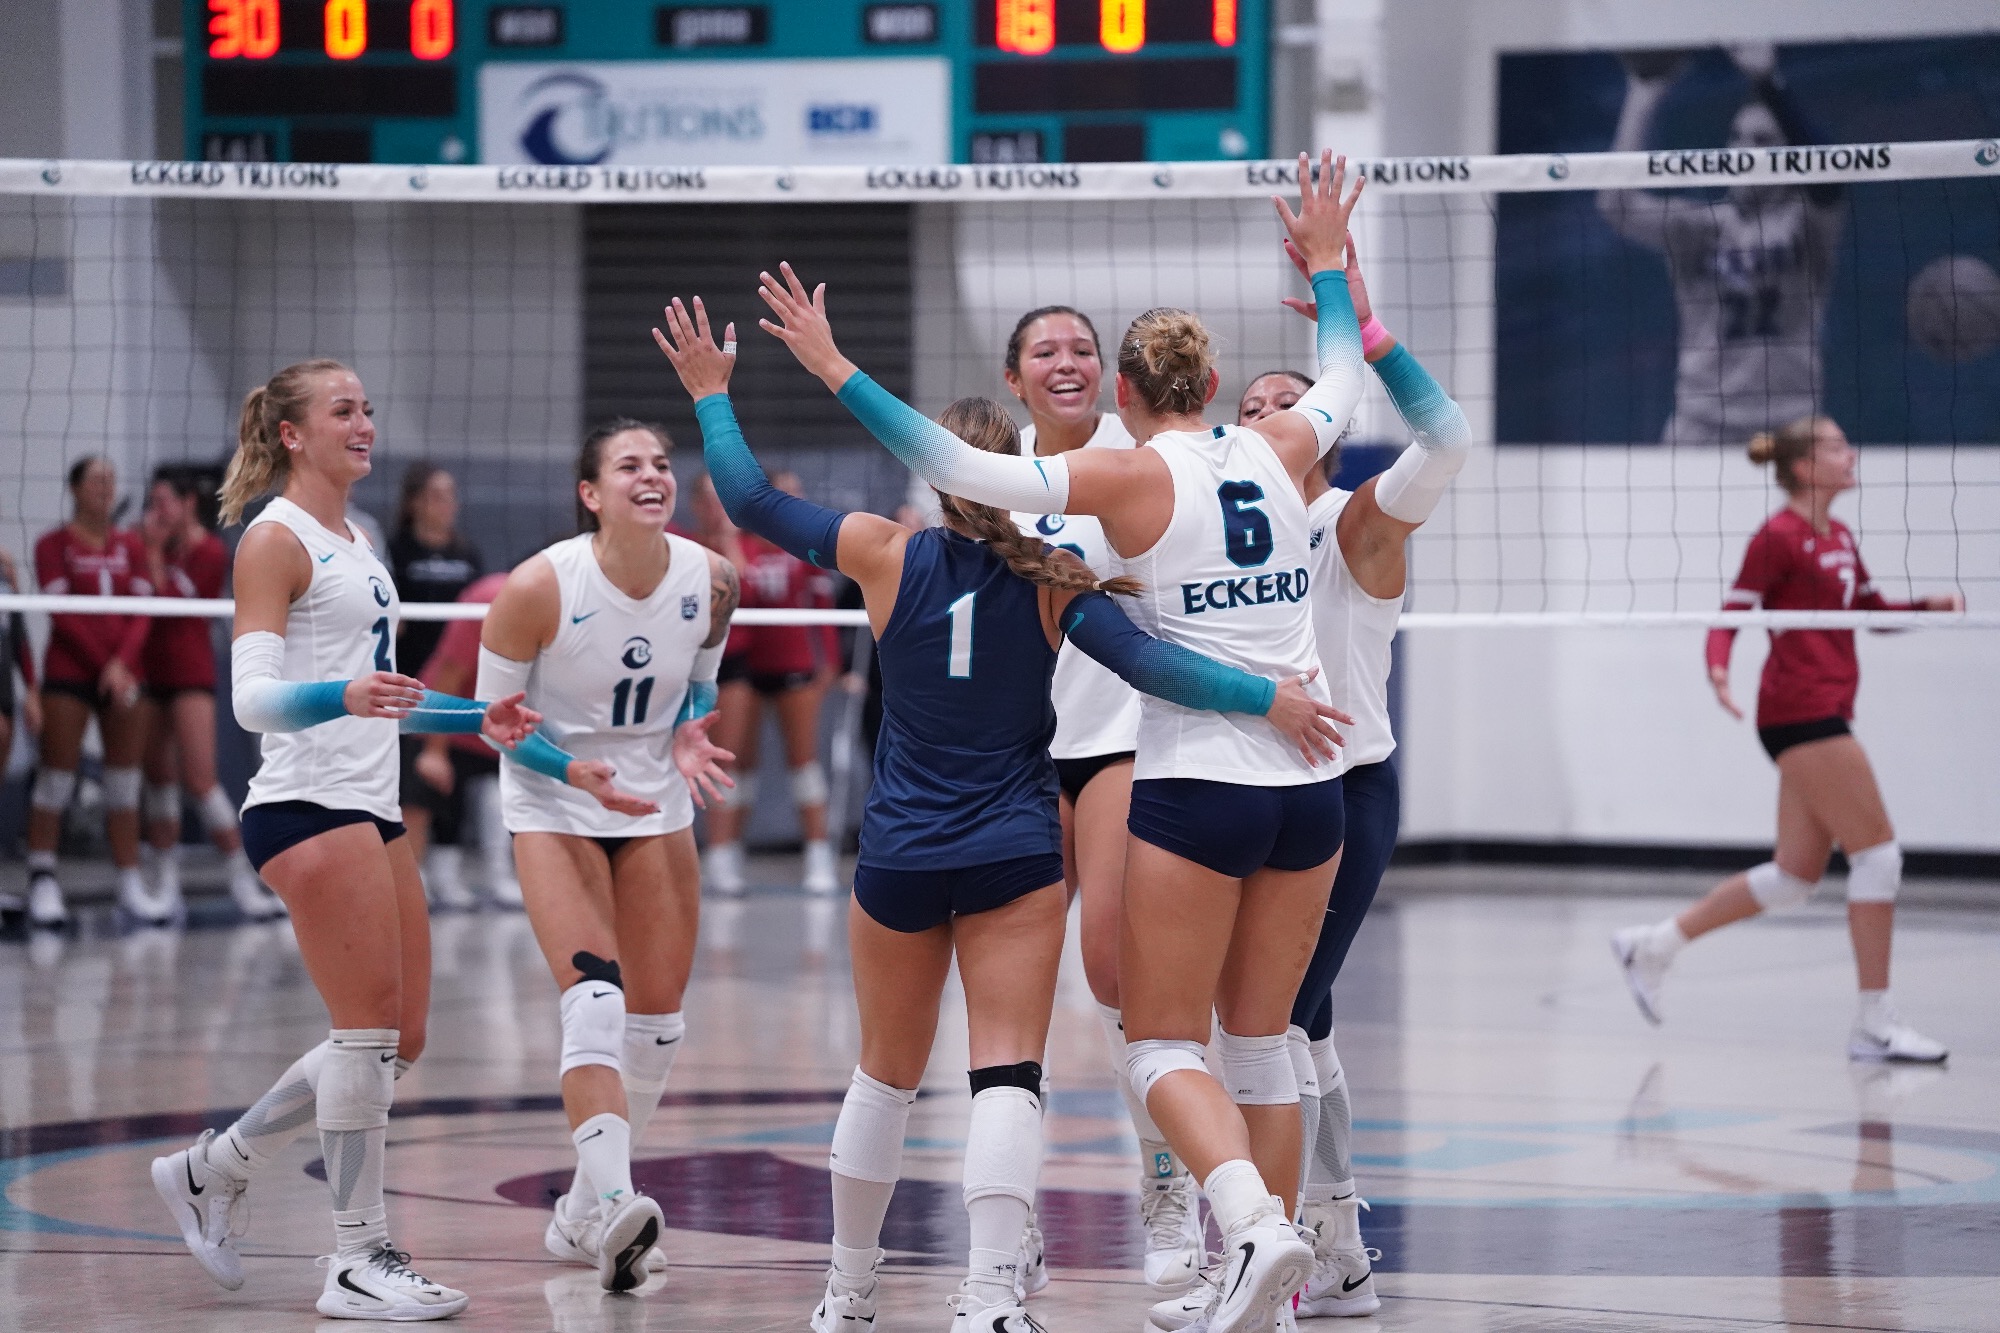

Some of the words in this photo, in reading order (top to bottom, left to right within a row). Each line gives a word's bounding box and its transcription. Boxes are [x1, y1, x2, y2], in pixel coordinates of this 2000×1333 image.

[208, 0, 281, 59] 30
[324, 0, 367, 60] 0
[410, 0, 454, 60] 0
[1099, 0, 1146, 54] 0
[1213, 0, 1238, 47] 1
[131, 163, 224, 186] ECKERD
[236, 164, 340, 188] TRITONS
[497, 169, 591, 190] ECKERD
[601, 168, 706, 191] TRITONS
[866, 168, 962, 190] ECKERD
[973, 168, 1080, 190] TRITONS
[1357, 158, 1470, 183] TRITONS
[1648, 150, 1755, 176] ECKERD
[1768, 146, 1891, 173] TRITONS
[1217, 479, 1274, 569] 6
[1181, 567, 1309, 614] ECKERD
[371, 616, 393, 673] 2
[946, 591, 977, 679] 1
[612, 676, 655, 726] 11
